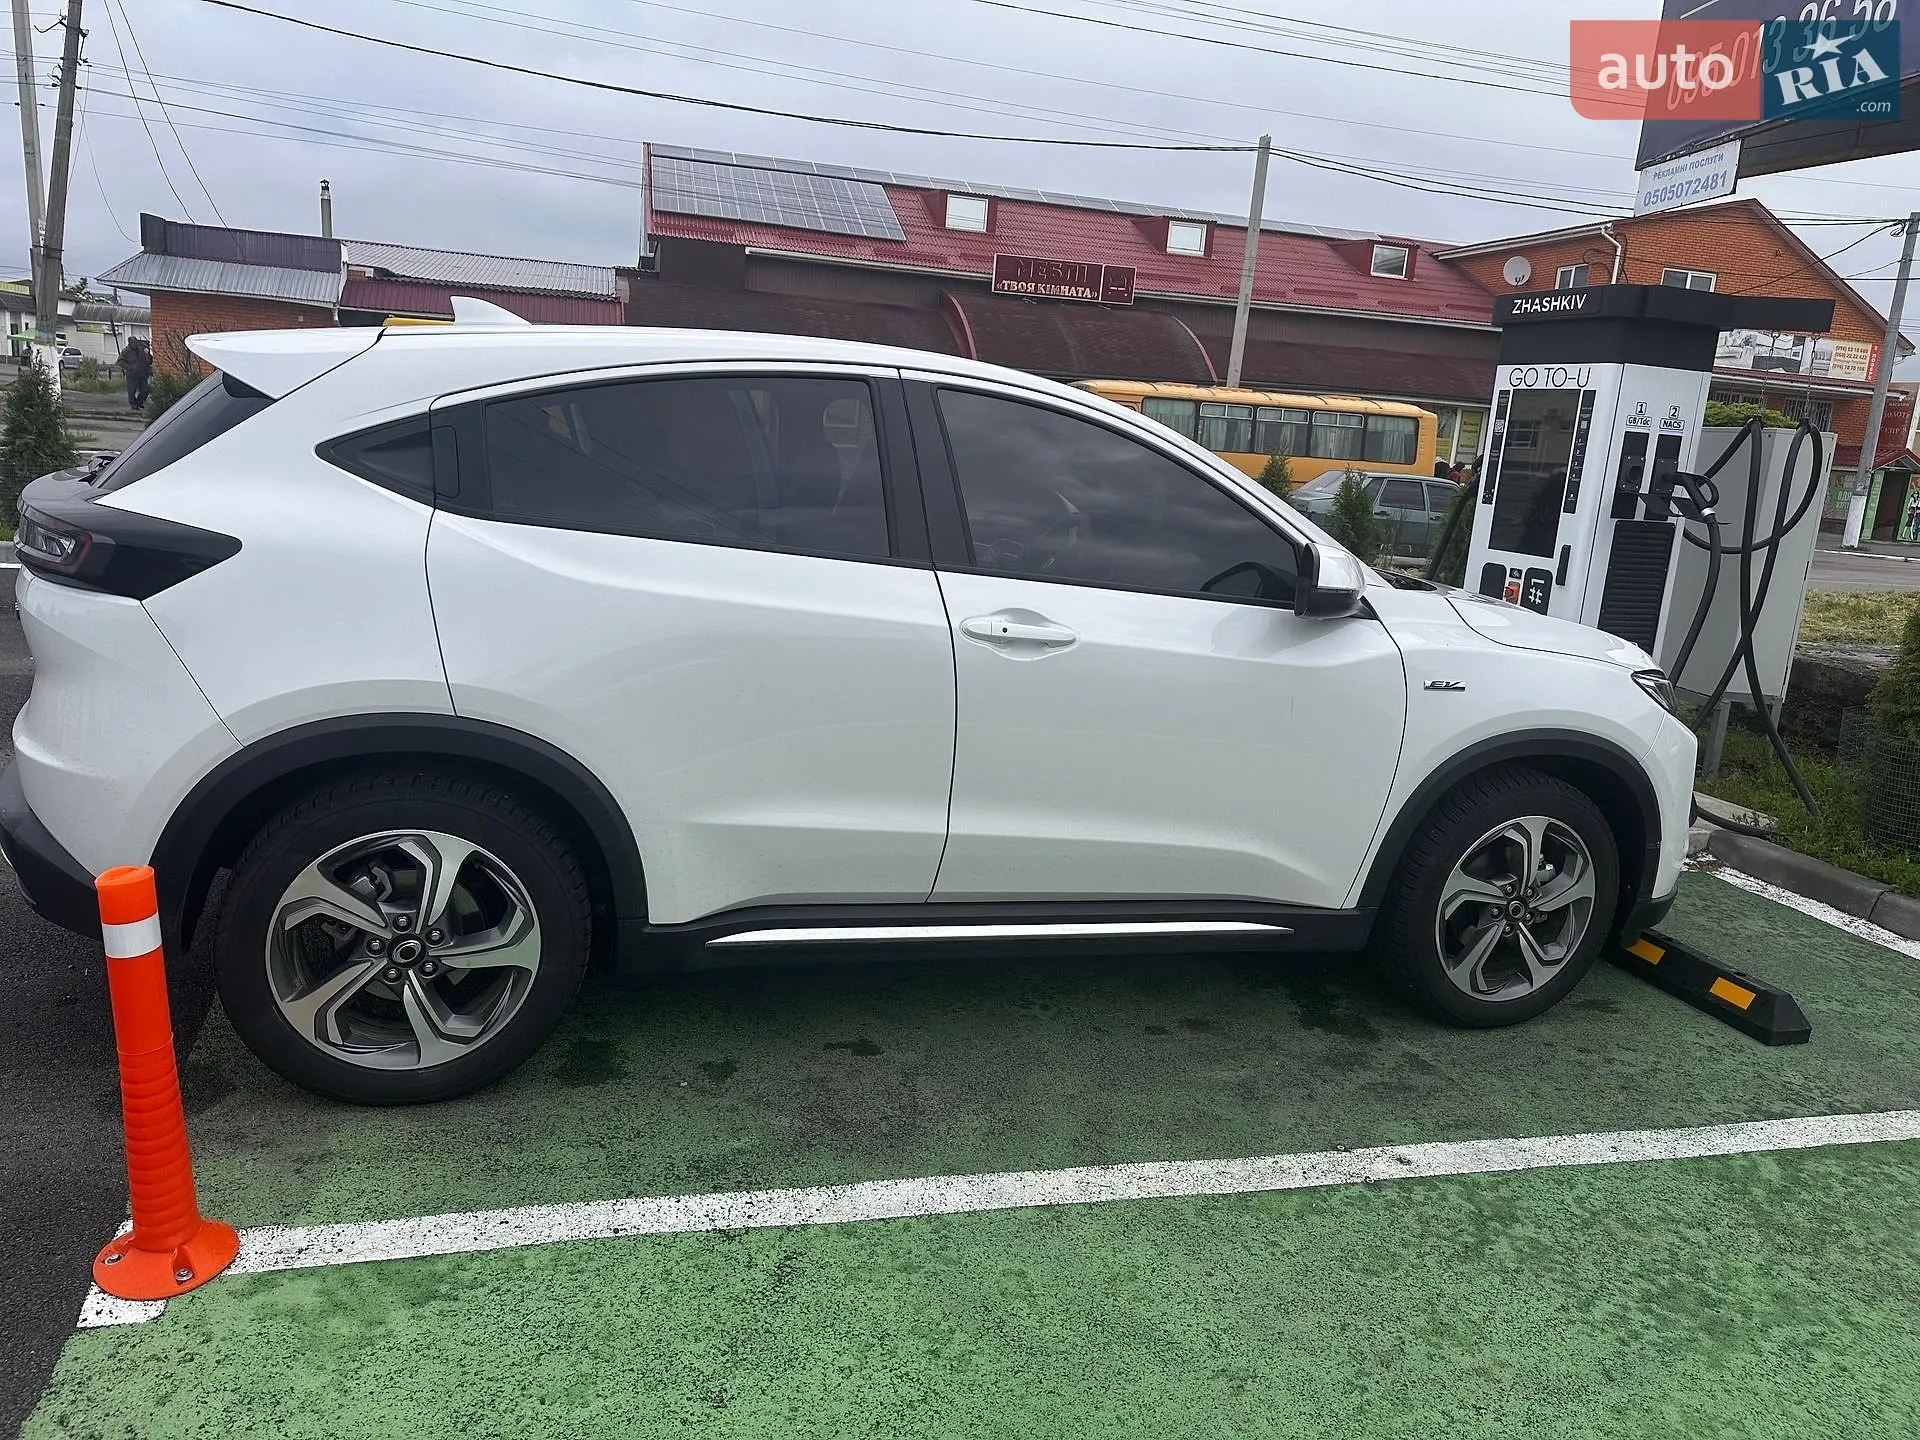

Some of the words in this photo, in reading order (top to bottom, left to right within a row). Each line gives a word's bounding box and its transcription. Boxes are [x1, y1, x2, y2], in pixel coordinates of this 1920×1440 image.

[1653, 164, 1688, 180] РЕКЛАМНІ
[1688, 153, 1724, 170] ПОСЛУГИ
[1643, 170, 1728, 207] 0505072481
[1037, 283, 1098, 299] КІМНАТА»
[1512, 293, 1587, 314] ZHASHKIV
[1509, 367, 1539, 388] GO
[1543, 367, 1592, 388] TO-U
[1637, 403, 1644, 414] 1
[1670, 406, 1678, 418] 2
[1662, 419, 1682, 429] NACS
